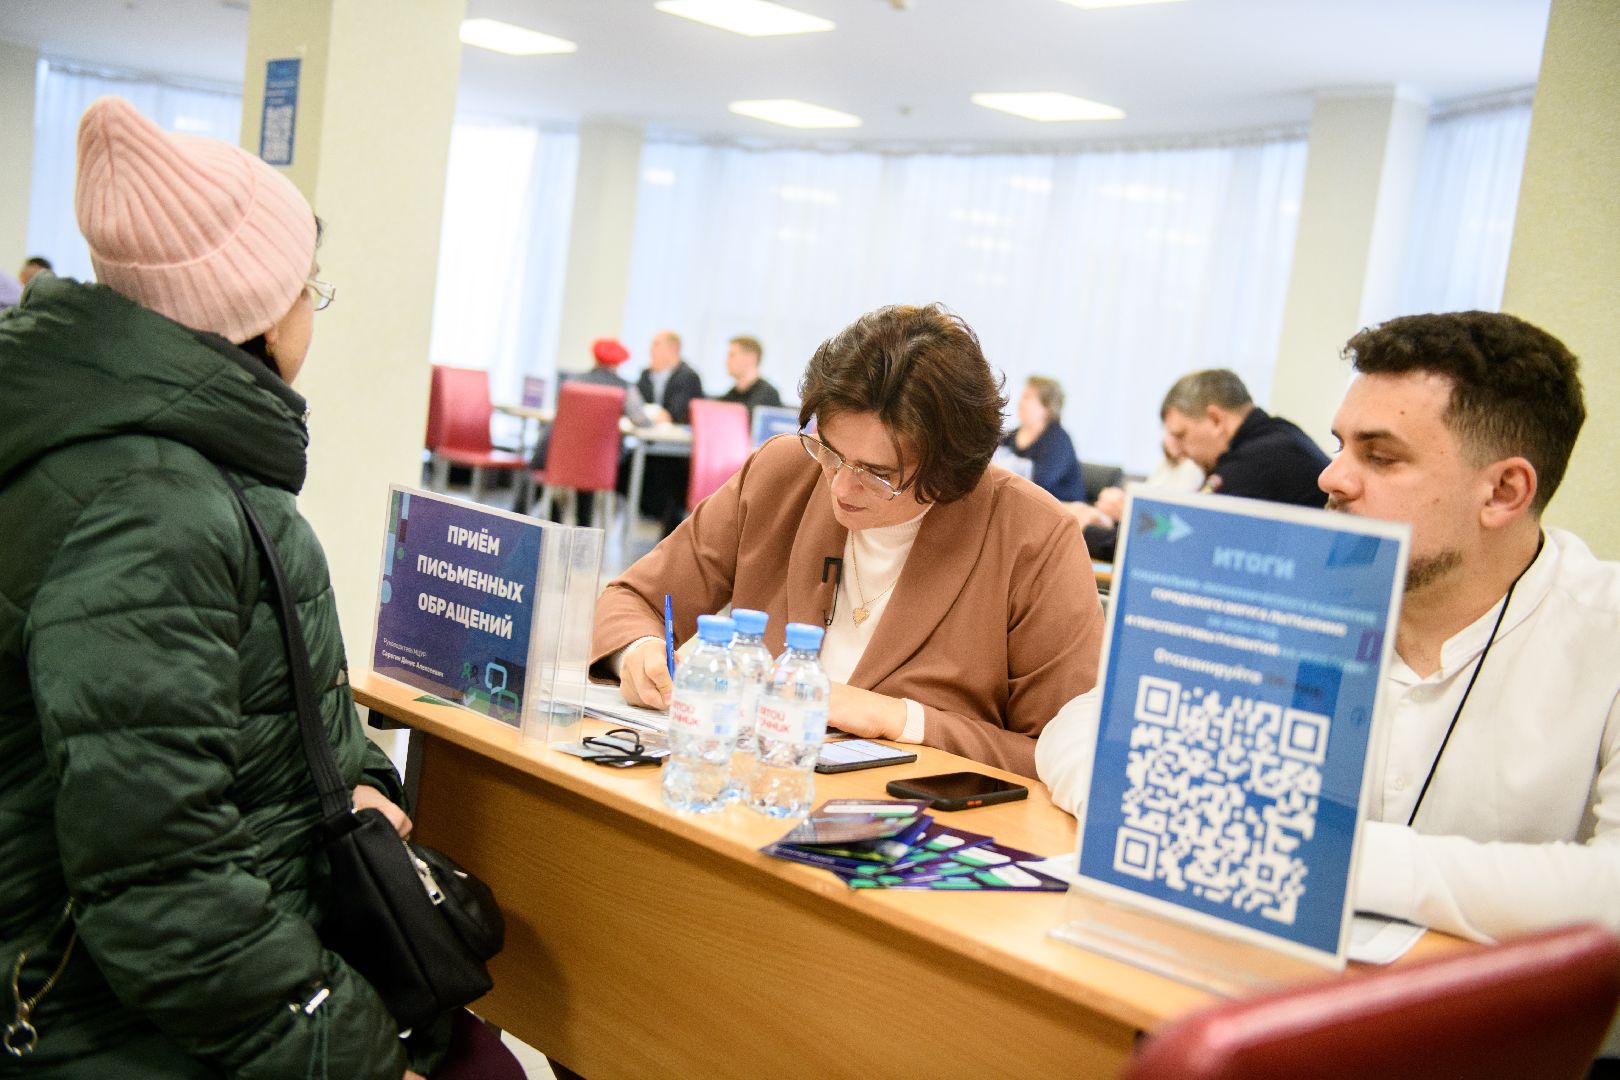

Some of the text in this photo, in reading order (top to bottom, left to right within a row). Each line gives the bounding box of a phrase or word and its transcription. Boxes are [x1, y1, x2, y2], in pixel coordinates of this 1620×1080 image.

[447, 525, 500, 556] ПРИЁМ
[416, 554, 524, 603] ПИСЬМЕННЫХ
[1212, 546, 1296, 581] ИТОГИ
[418, 592, 513, 640] ОБРАЩЕНИЙ
